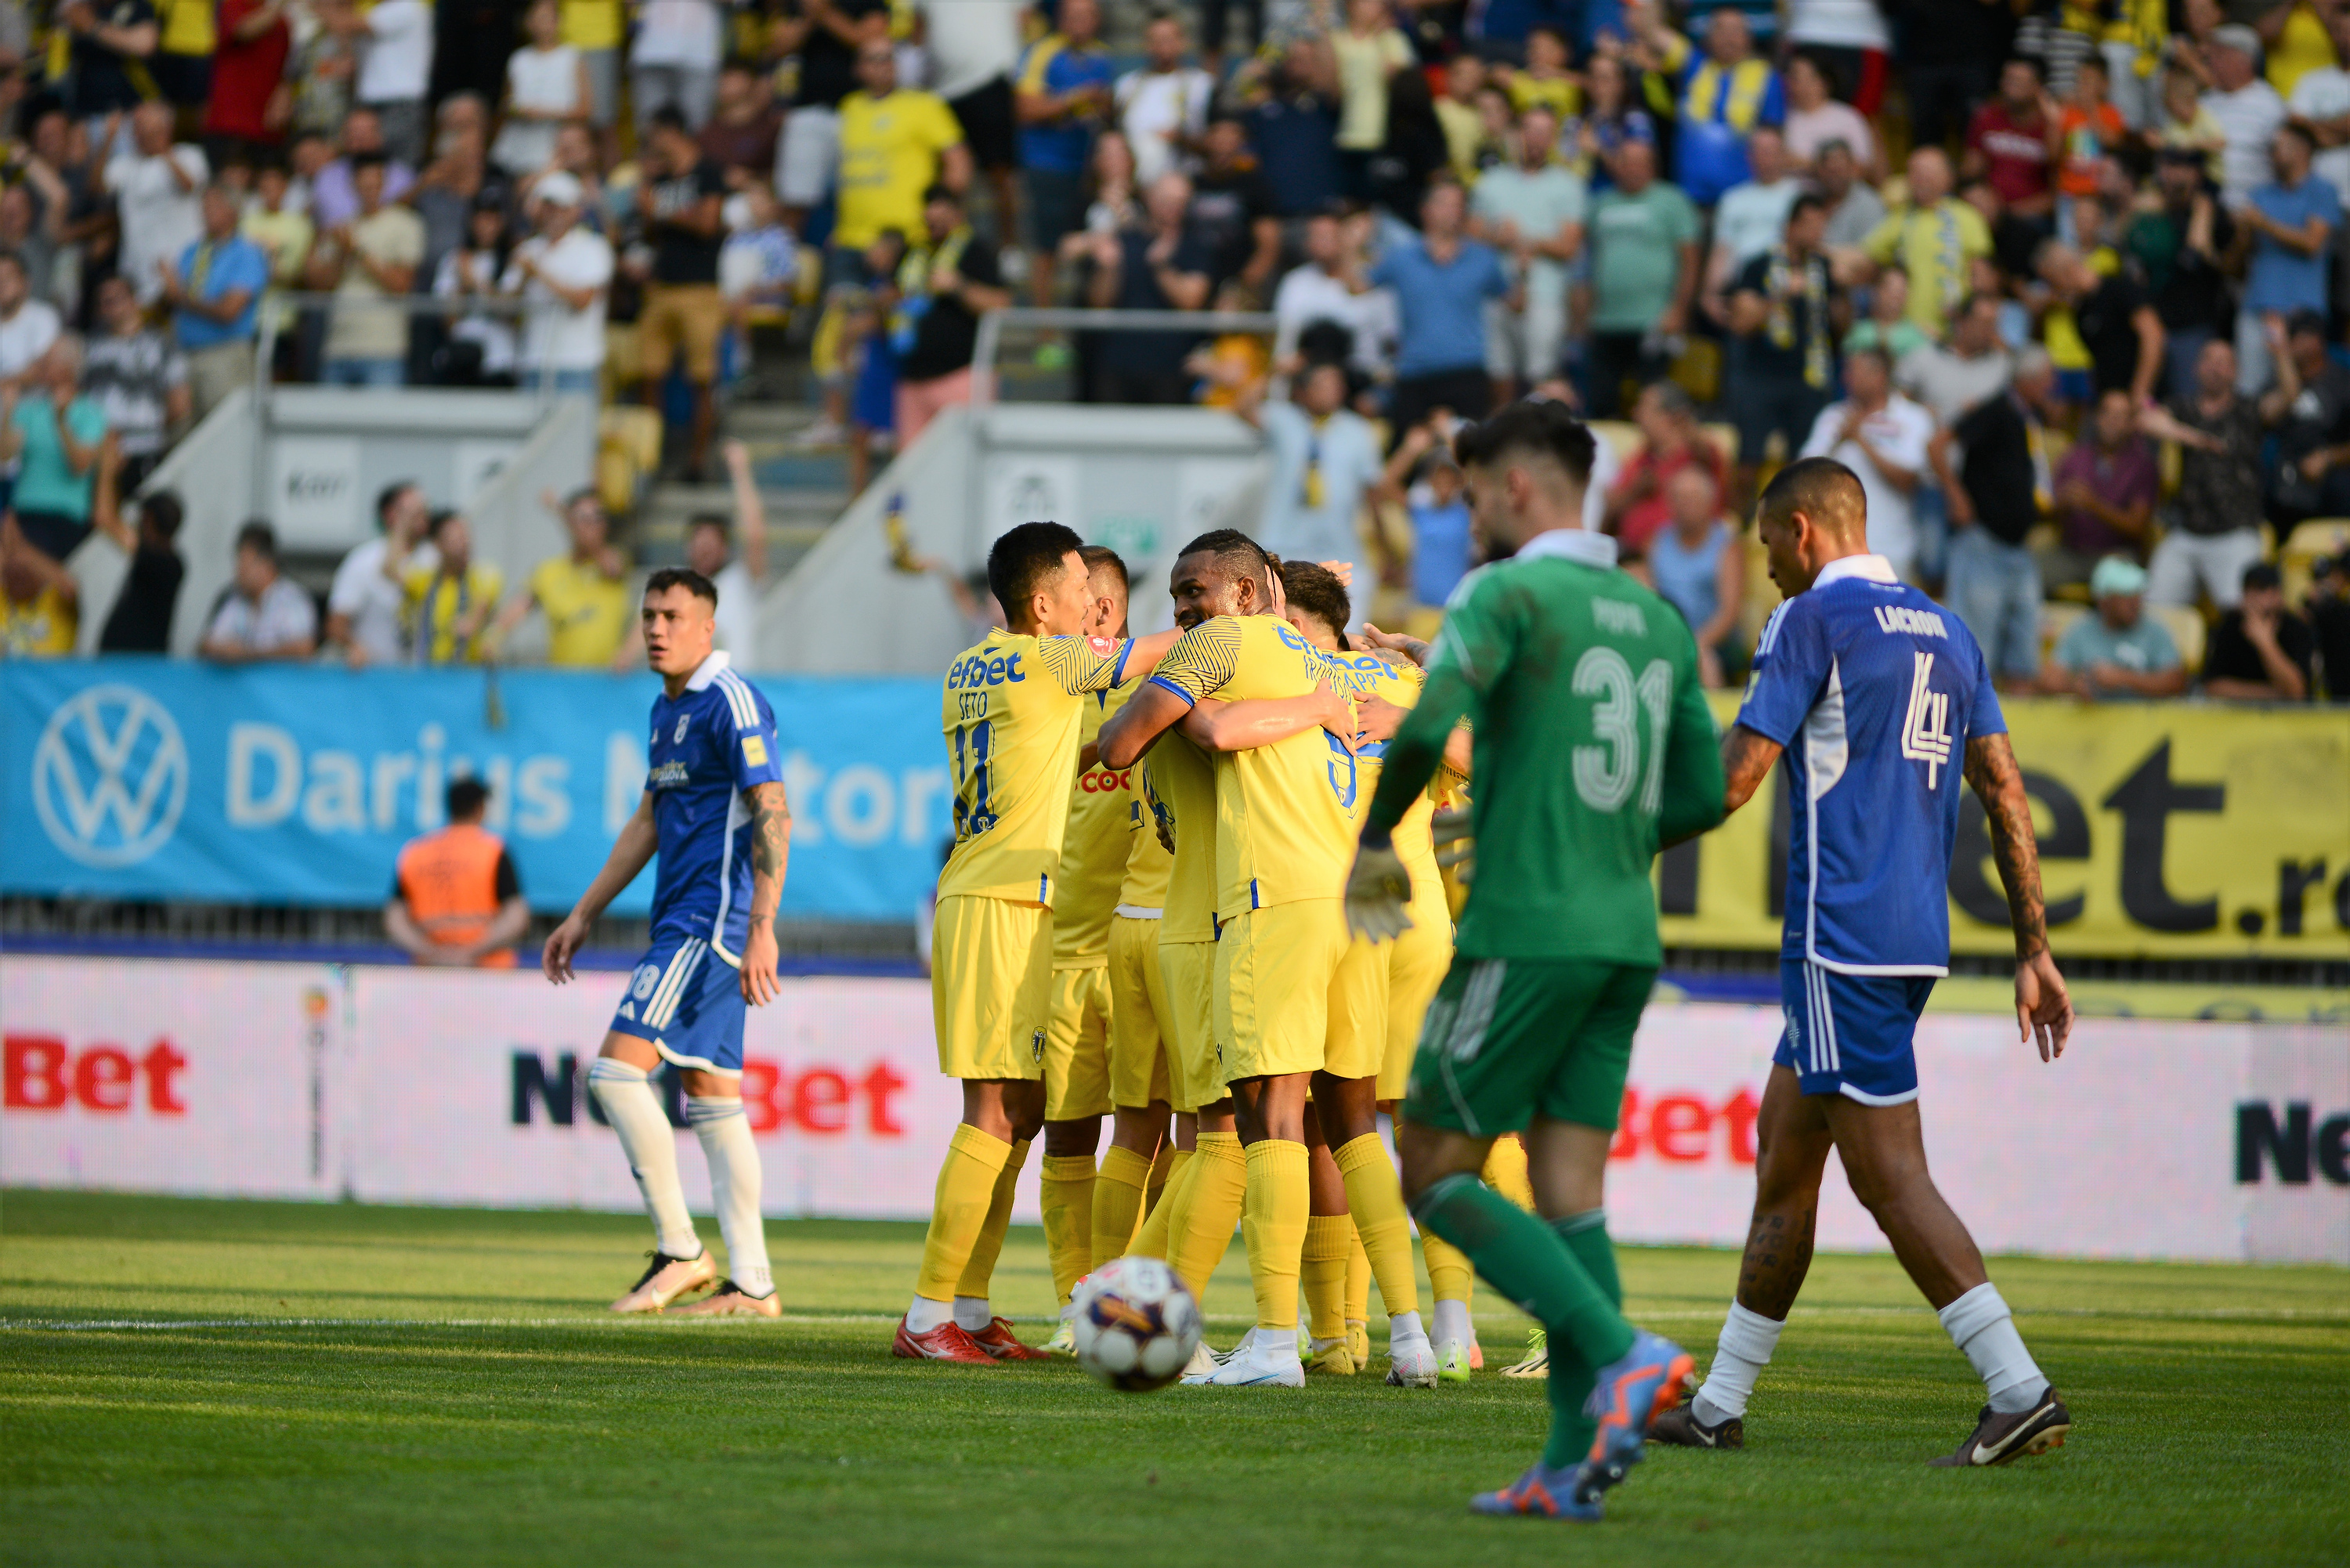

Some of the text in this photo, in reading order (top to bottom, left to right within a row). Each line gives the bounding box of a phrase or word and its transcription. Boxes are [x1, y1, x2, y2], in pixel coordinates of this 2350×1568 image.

[948, 651, 1025, 689] efbet
[959, 692, 988, 721] SETO
[1901, 651, 1952, 790] 4
[953, 720, 1000, 842] 11
[1571, 645, 1673, 815] 31
[512, 1051, 906, 1136] NBet
